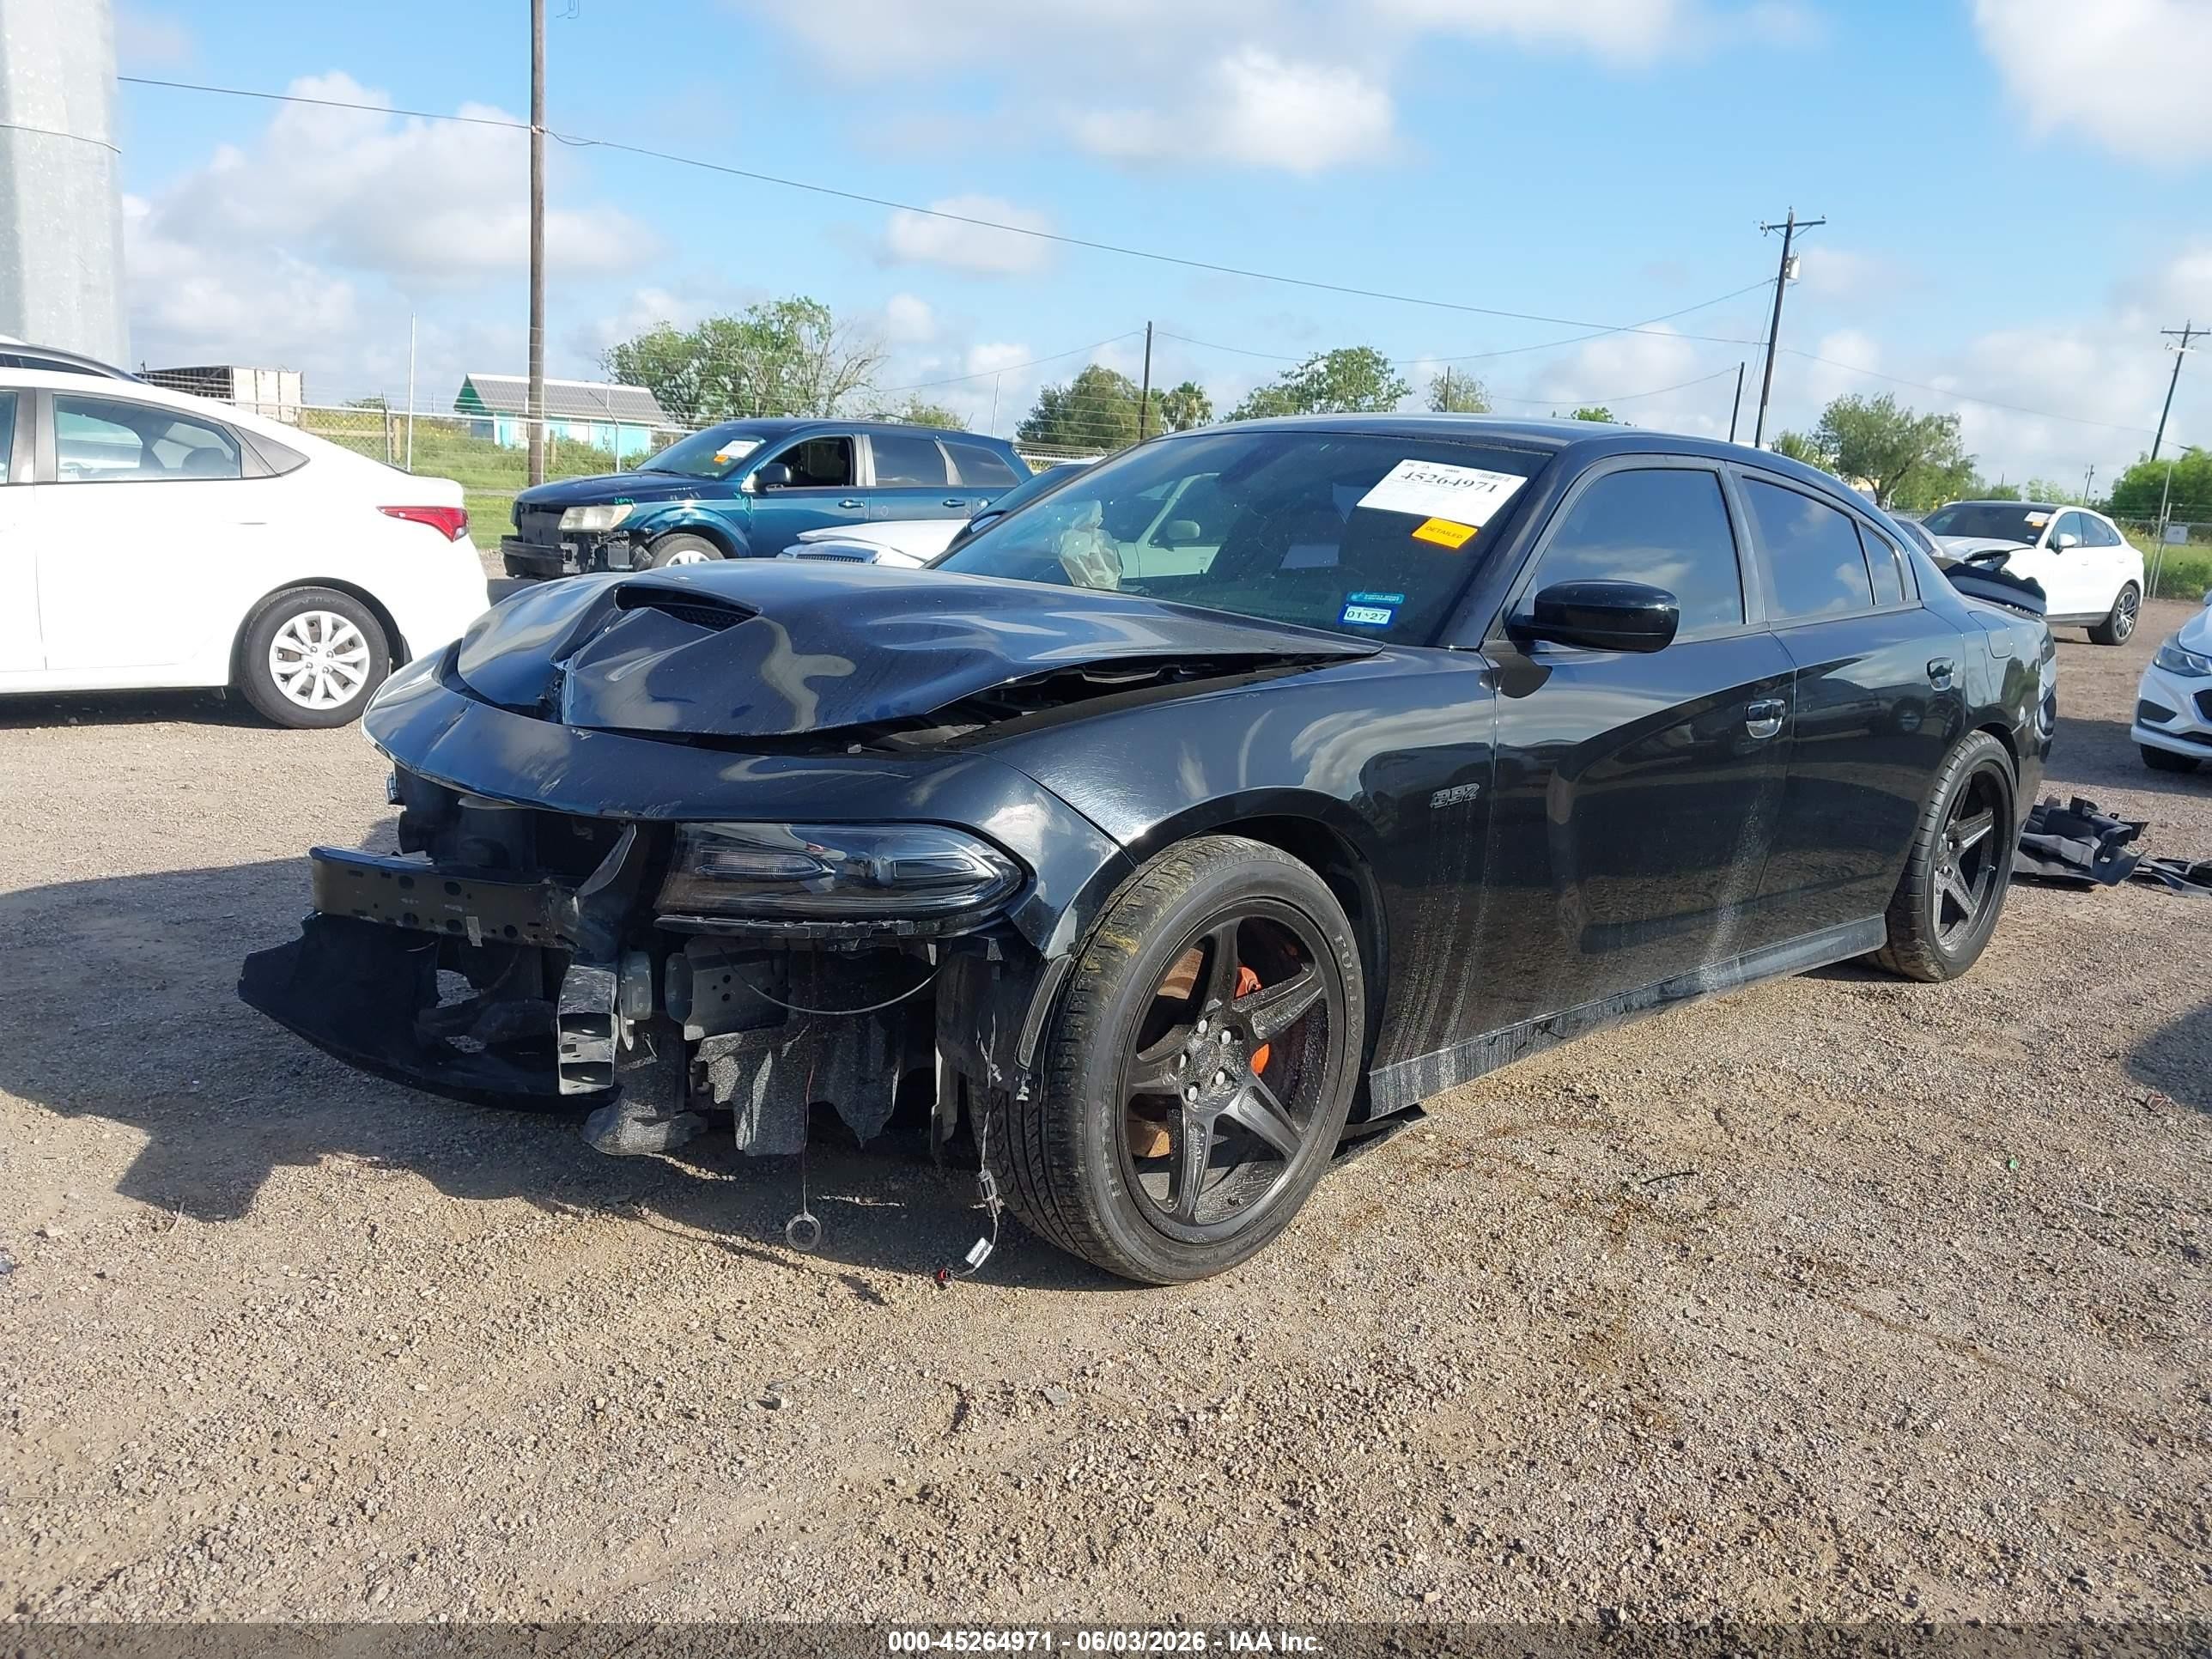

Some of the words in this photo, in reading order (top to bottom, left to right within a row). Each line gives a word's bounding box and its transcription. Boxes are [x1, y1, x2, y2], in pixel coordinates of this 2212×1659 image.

[1400, 471, 1498, 493] 45264971
[1425, 526, 1464, 540] DETAILED
[1346, 611, 1362, 619] 01
[1369, 611, 1388, 622] 27
[1429, 782, 1480, 809] 392
